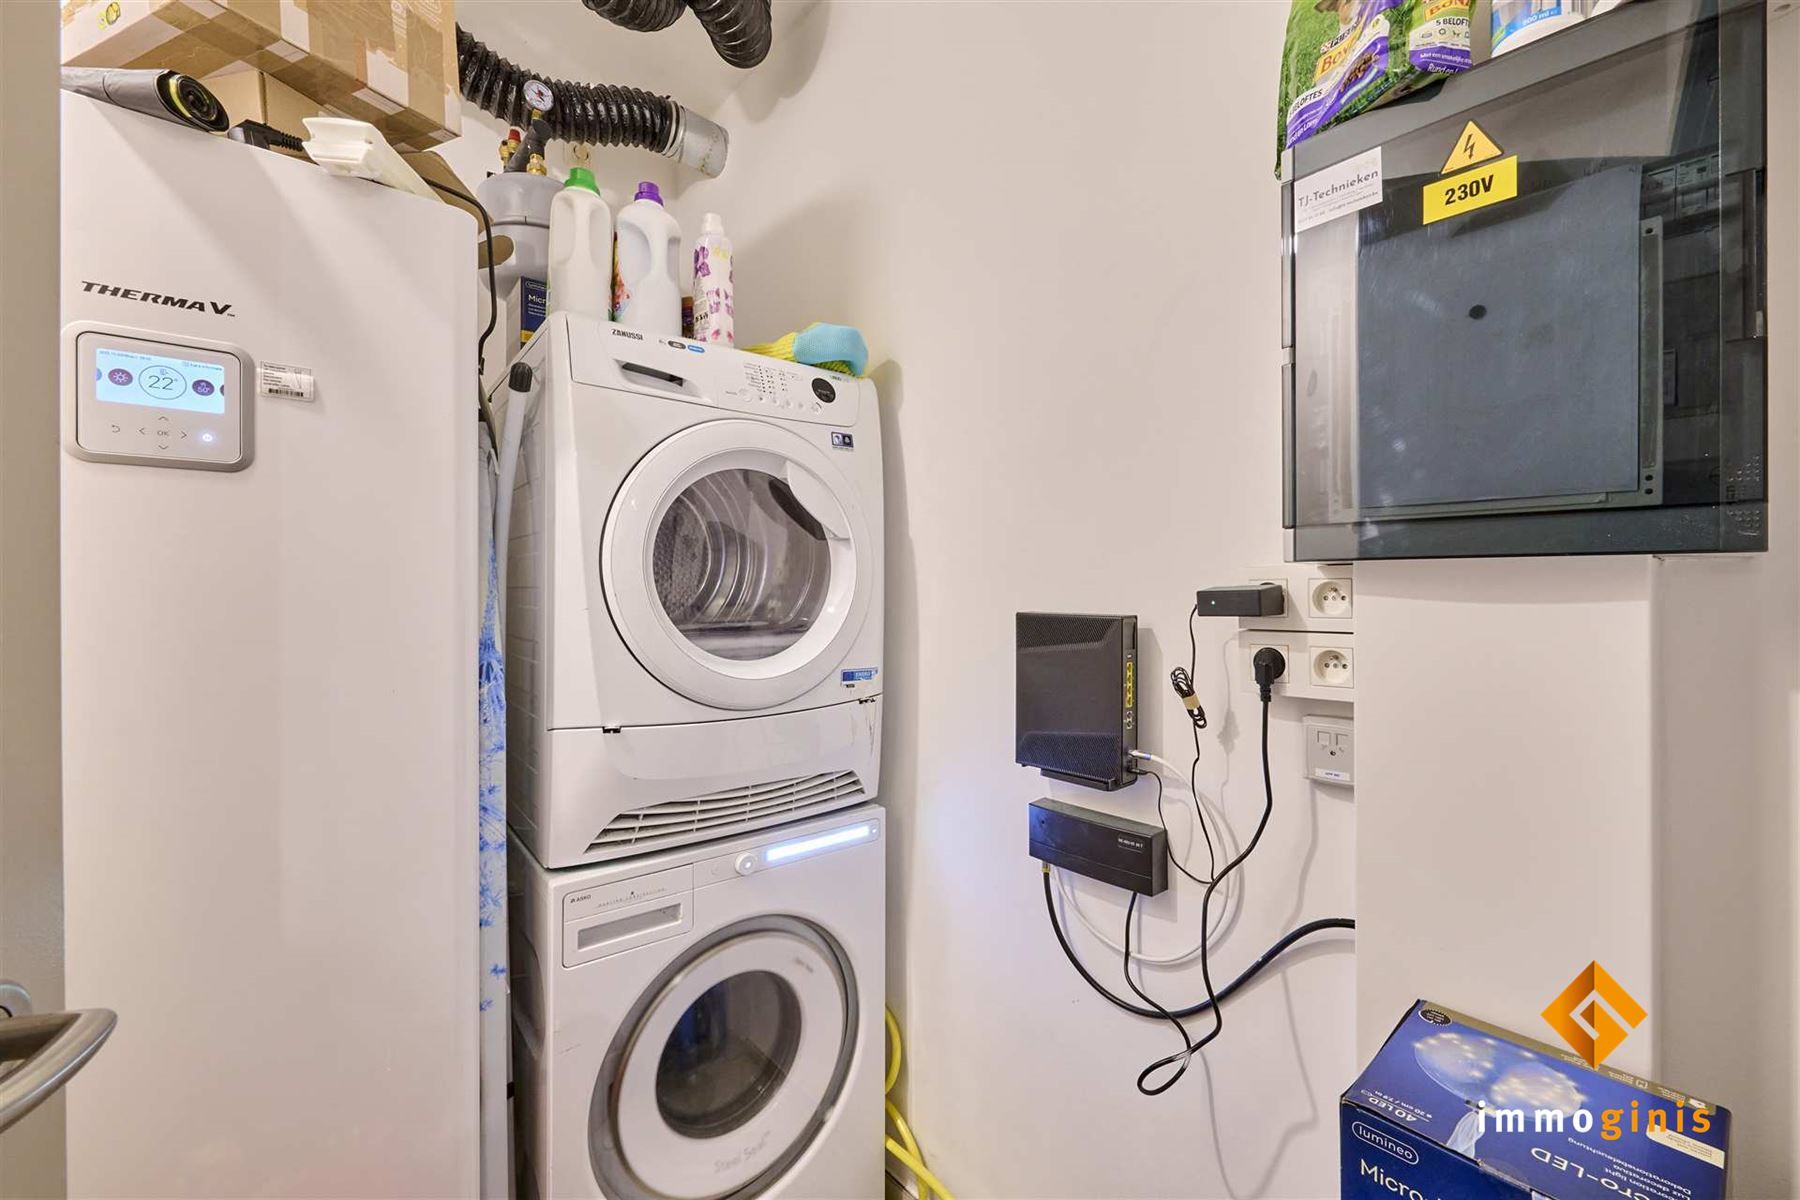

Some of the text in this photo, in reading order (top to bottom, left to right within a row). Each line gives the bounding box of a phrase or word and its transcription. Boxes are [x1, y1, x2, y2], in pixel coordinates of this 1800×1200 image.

[1298, 170, 1379, 208] TJ-Technieken
[1444, 174, 1494, 205] 230V
[611, 328, 644, 341] ZANUSSI
[1368, 1097, 1417, 1122] 40 LED
[1359, 1125, 1413, 1160] lumineo
